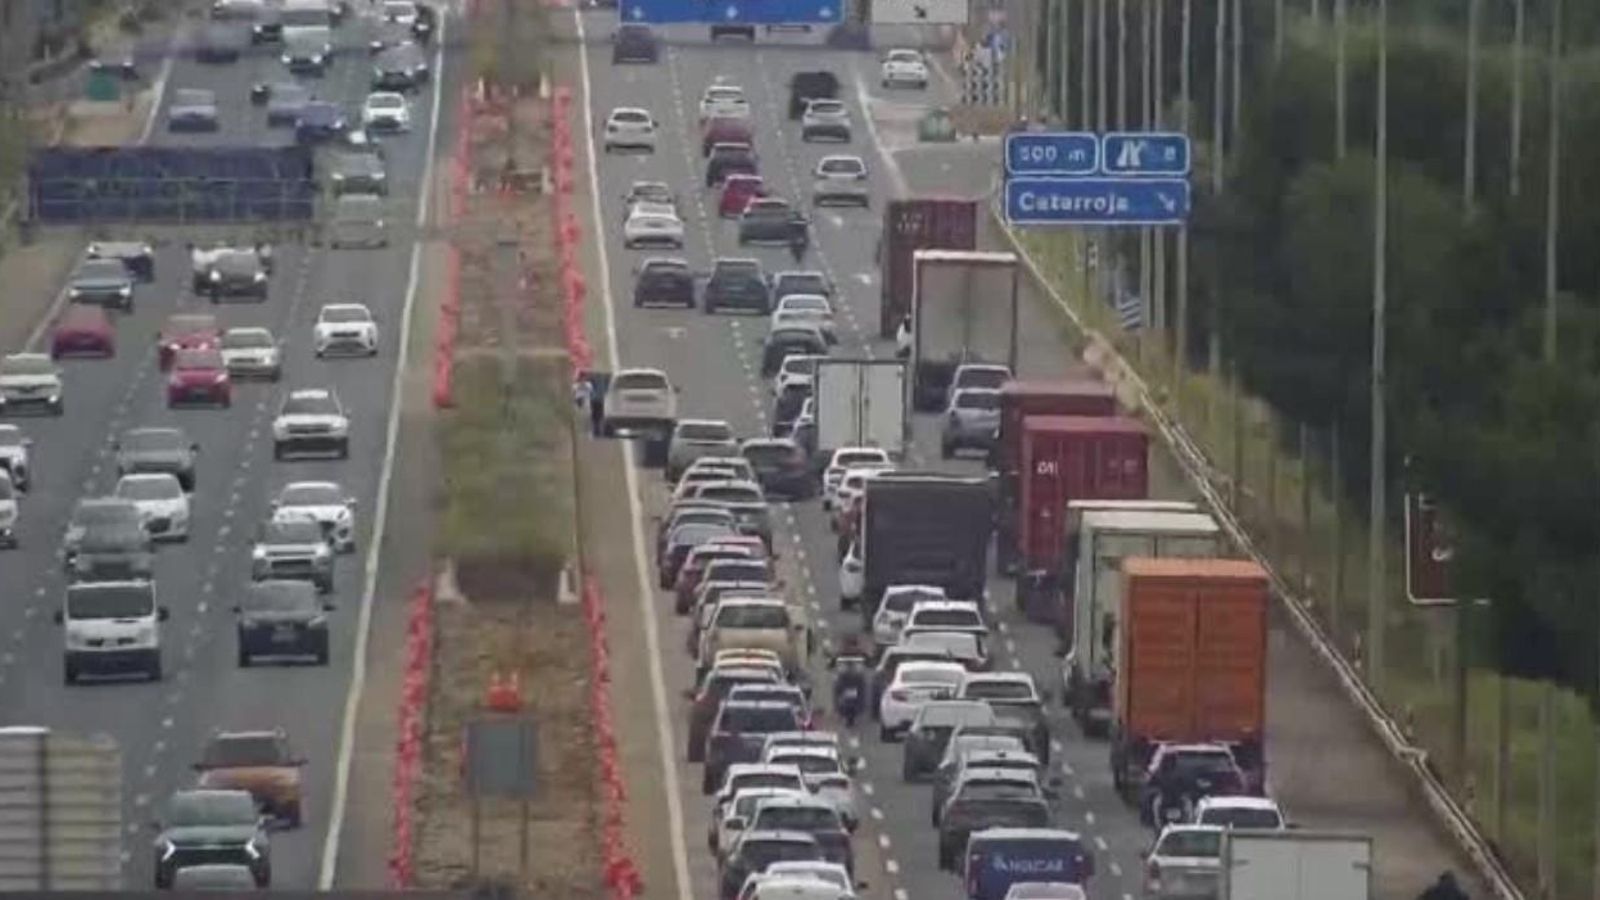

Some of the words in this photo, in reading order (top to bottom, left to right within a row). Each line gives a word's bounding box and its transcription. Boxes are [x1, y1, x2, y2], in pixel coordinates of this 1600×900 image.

[1019, 144, 1057, 161] 500
[1068, 149, 1085, 161] m
[1018, 192, 1129, 214] Catarroja
